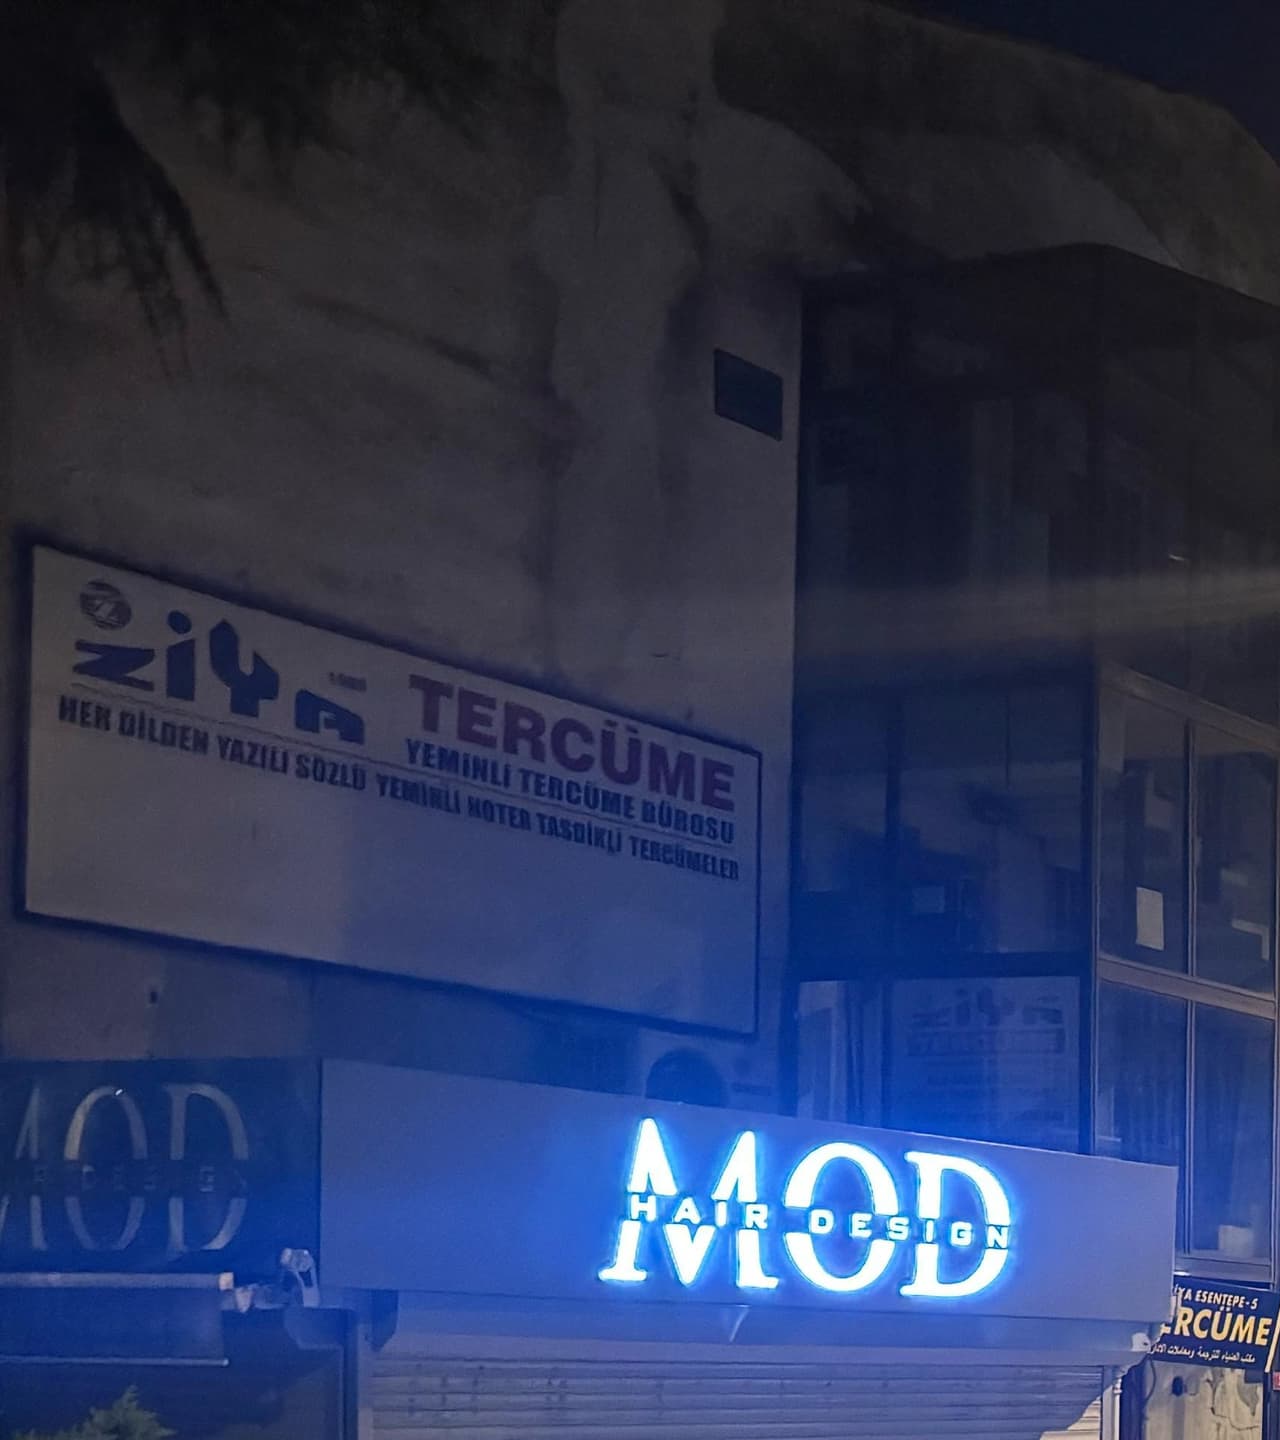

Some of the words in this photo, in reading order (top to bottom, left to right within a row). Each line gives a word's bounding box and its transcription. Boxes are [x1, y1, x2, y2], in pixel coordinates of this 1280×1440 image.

[59, 695, 111, 732] HER
[118, 708, 209, 756] DİLDEN
[409, 674, 735, 812] TERCÜME
[406, 738, 511, 790] YEMİNLİ
[518, 767, 635, 820] TERCÜME
[642, 799, 735, 844] BÜROSU
[599, 1117, 1012, 1298] MOD
[630, 1194, 769, 1230] HAIR
[808, 1208, 1010, 1249] DESIGN
